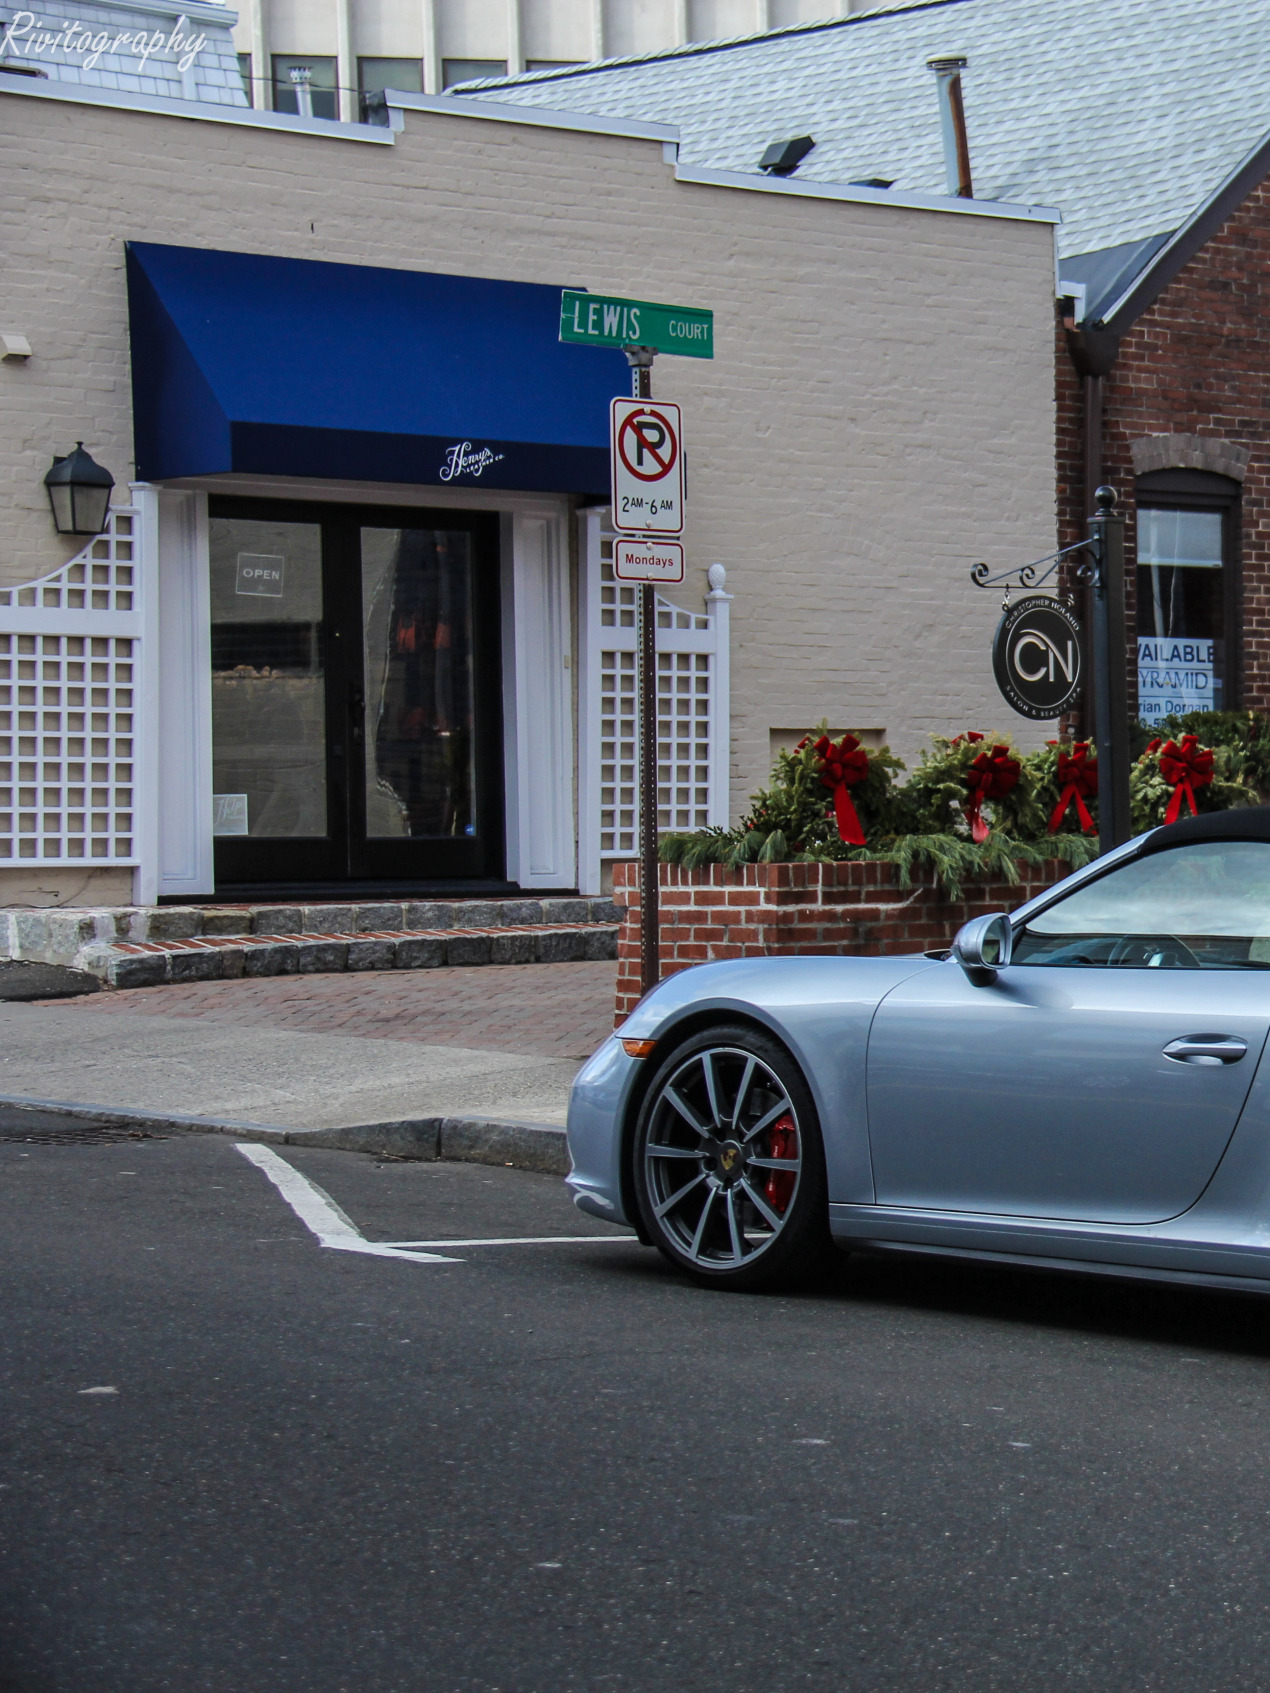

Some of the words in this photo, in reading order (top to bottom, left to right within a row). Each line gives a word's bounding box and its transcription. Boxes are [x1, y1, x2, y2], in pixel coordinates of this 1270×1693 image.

[573, 300, 641, 340] LEWIS
[669, 320, 709, 341] COURT
[242, 568, 280, 580] OPEN
[625, 553, 674, 568] Mondays
[1005, 599, 1050, 629] CHRISTOPHER
[1013, 629, 1073, 682] CN
[1006, 685, 1029, 712] SALON
[1040, 702, 1067, 717] BEAUTY
